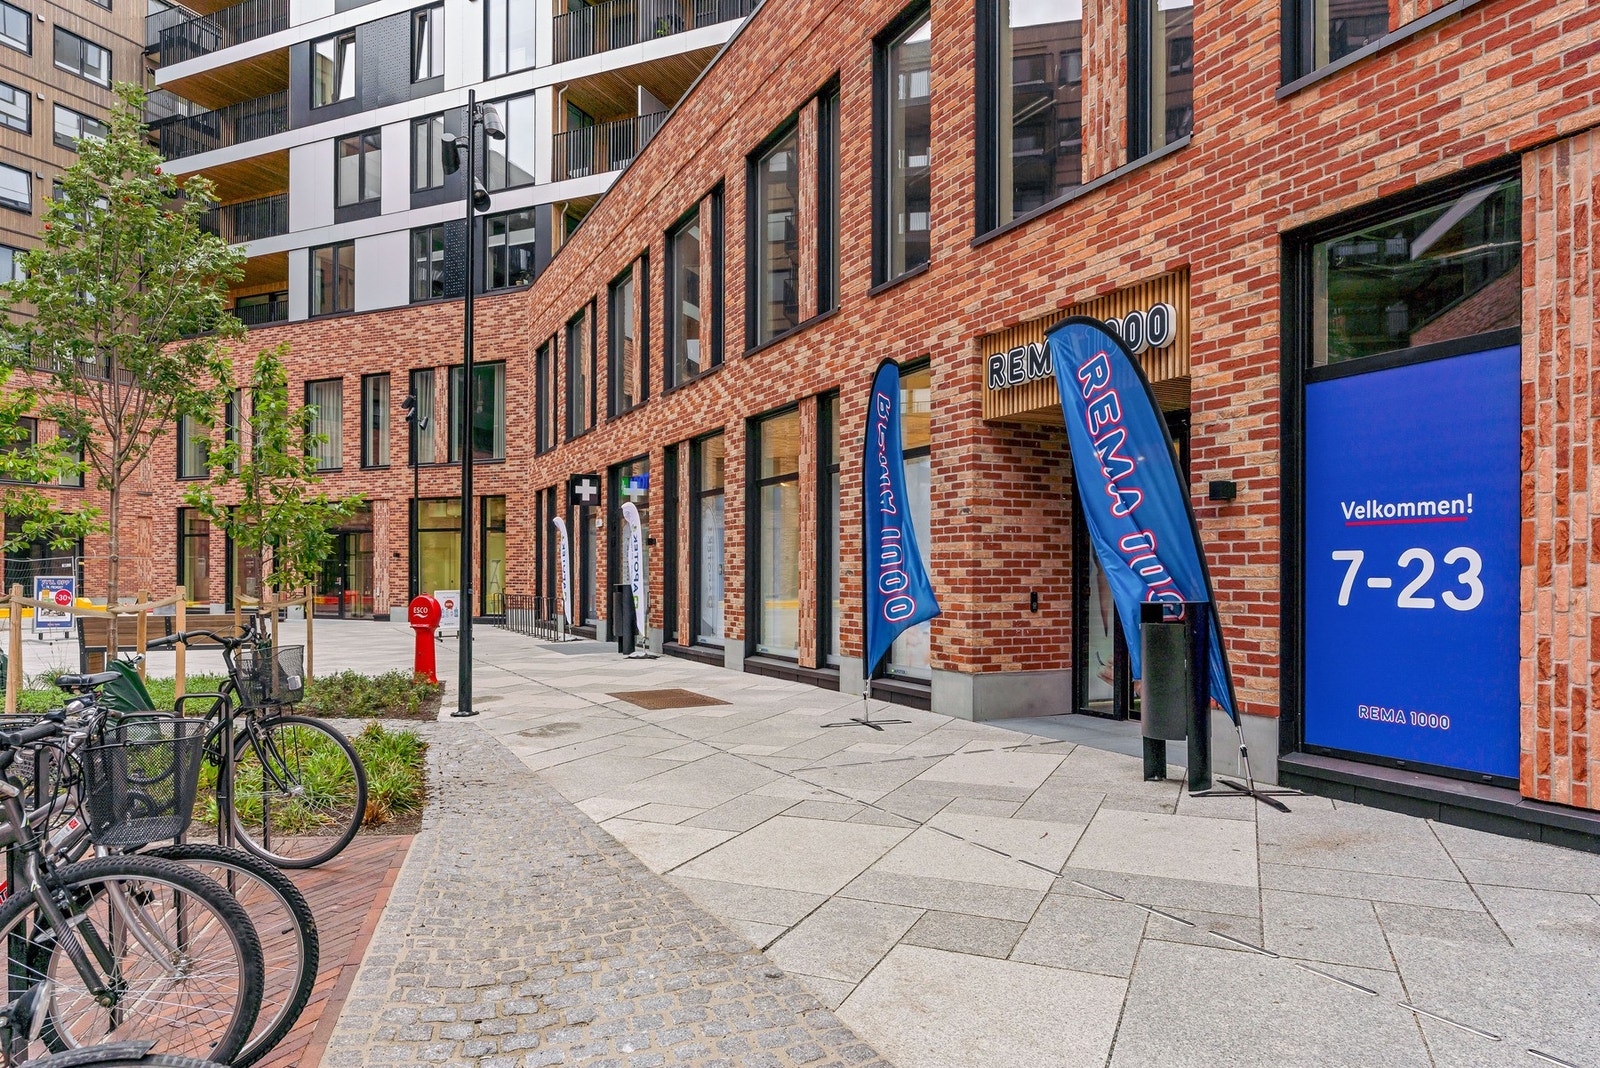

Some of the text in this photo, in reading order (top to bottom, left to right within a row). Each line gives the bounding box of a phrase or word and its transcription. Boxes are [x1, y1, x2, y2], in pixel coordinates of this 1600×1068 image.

[988, 339, 1066, 391] REM
[1078, 350, 1144, 518] REMA
[1341, 493, 1473, 519] Velkommen!
[1332, 546, 1485, 611] 7-23
[413, 606, 428, 614] ESCO
[1358, 705, 1450, 730] REMA 1000
